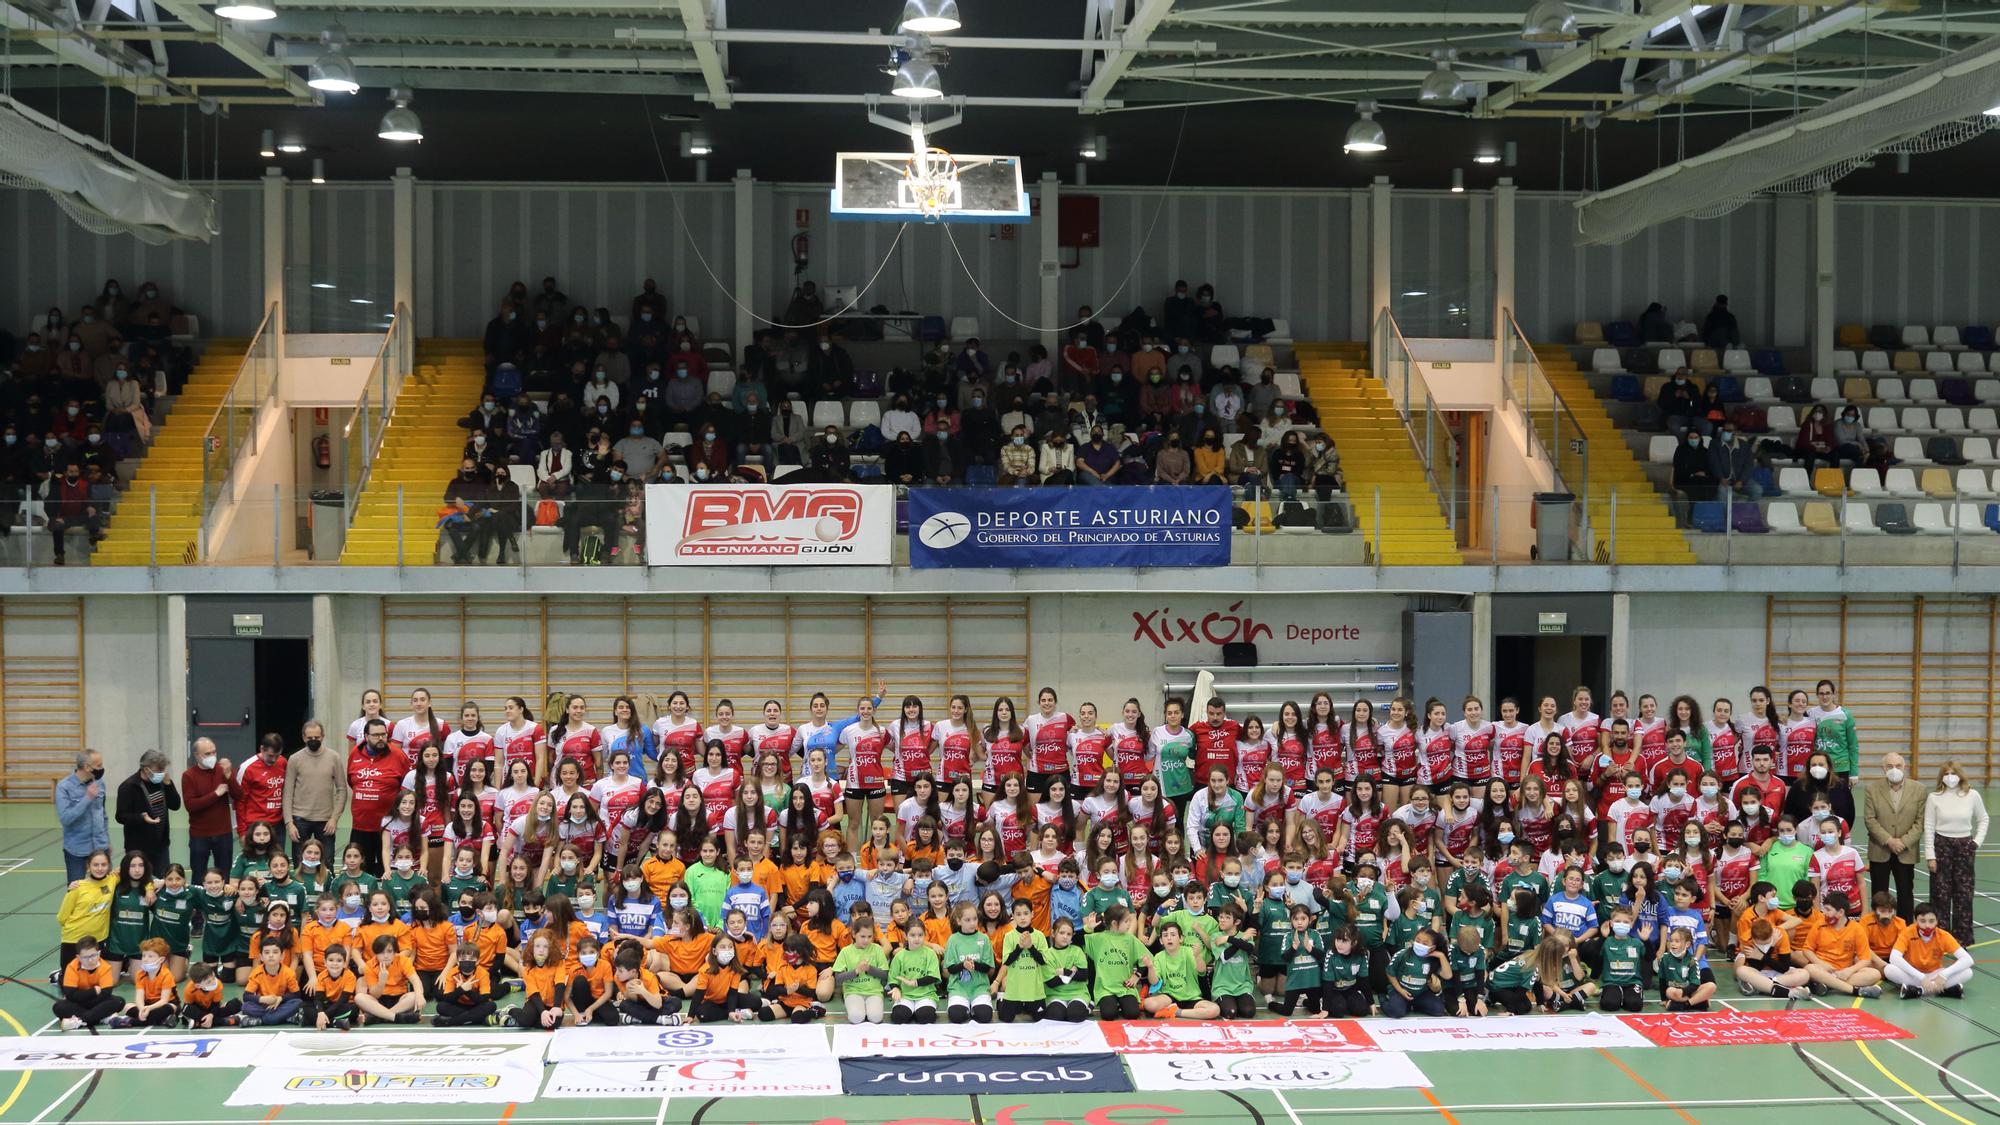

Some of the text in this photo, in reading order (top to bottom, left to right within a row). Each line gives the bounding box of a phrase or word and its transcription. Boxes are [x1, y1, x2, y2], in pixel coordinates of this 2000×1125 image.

[682, 489, 863, 541] BMG
[977, 509, 1221, 527] DEPORTE ASTURIANO
[681, 544, 854, 554] BALONMANO GIJÓN
[1286, 624, 1360, 645] Deporte
[619, 914, 647, 925] GMD
[1556, 912, 1582, 926] GMD
[1378, 1027, 1470, 1035] UNIVERSO
[1452, 1031, 1560, 1039] BALONMANO
[585, 1048, 787, 1057] servipesa
[869, 1066, 1094, 1084] sumcab
[1174, 1069, 1338, 1082] Conde
